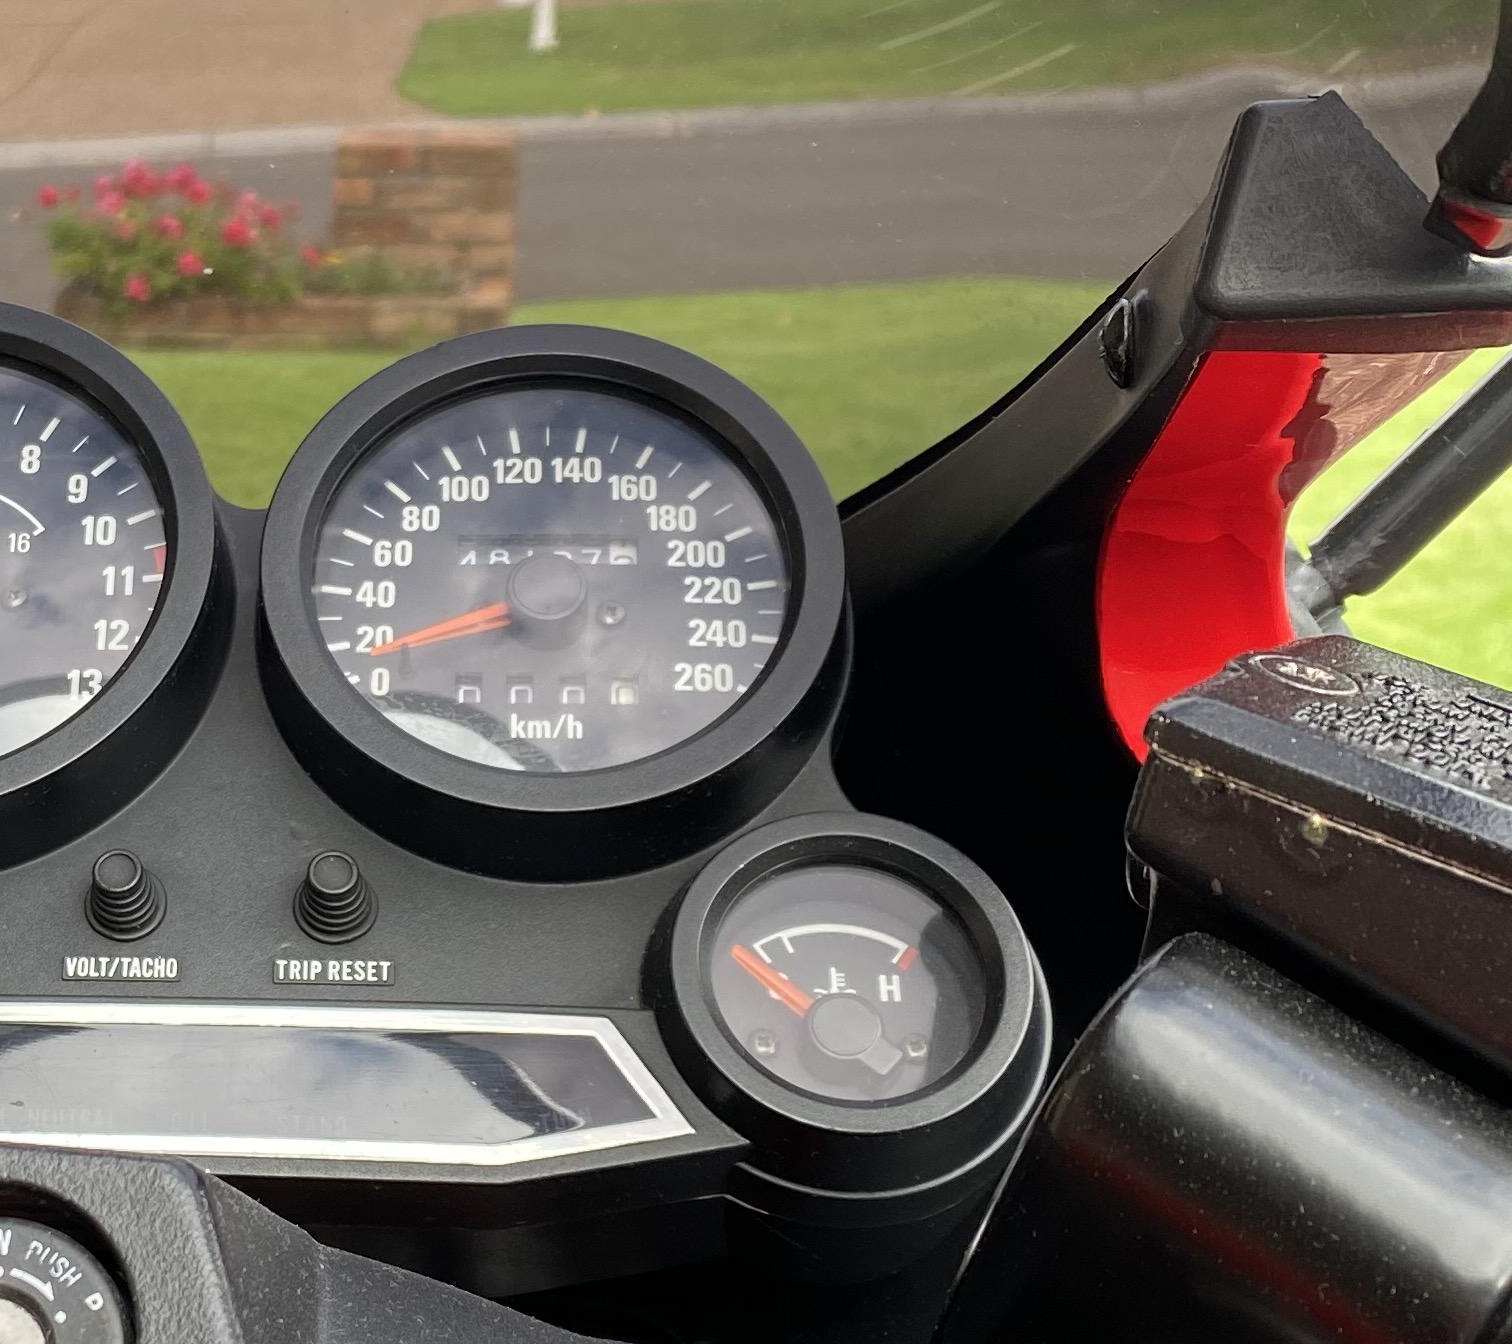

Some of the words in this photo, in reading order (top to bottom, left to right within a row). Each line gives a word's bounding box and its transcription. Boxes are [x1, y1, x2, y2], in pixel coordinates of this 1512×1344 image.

[20, 445, 41, 473] 8
[493, 457, 542, 484] 120
[551, 457, 602, 483] 140
[67, 474, 88, 502] 9
[438, 476, 489, 502] 100
[608, 475, 658, 501] 160
[81, 515, 116, 545] 10
[402, 506, 440, 532] 80
[646, 505, 697, 532] 180
[8, 533, 31, 553] 16
[373, 541, 413, 567] 60
[667, 541, 725, 567] 200
[101, 567, 133, 594] 11
[684, 577, 741, 604] 220
[355, 581, 395, 608] 40
[94, 620, 129, 650] 12
[355, 625, 394, 654] 20
[688, 620, 746, 647] 240
[66, 669, 103, 698] 13
[370, 669, 390, 696] 0
[673, 663, 733, 692] 260
[510, 714, 584, 739] km/h
[65, 956, 178, 978] VOLT/TACHO
[276, 959, 323, 981] TRIP
[328, 960, 391, 982] RESET
[878, 975, 902, 1002] H
[24, 1240, 82, 1287] PUSH
